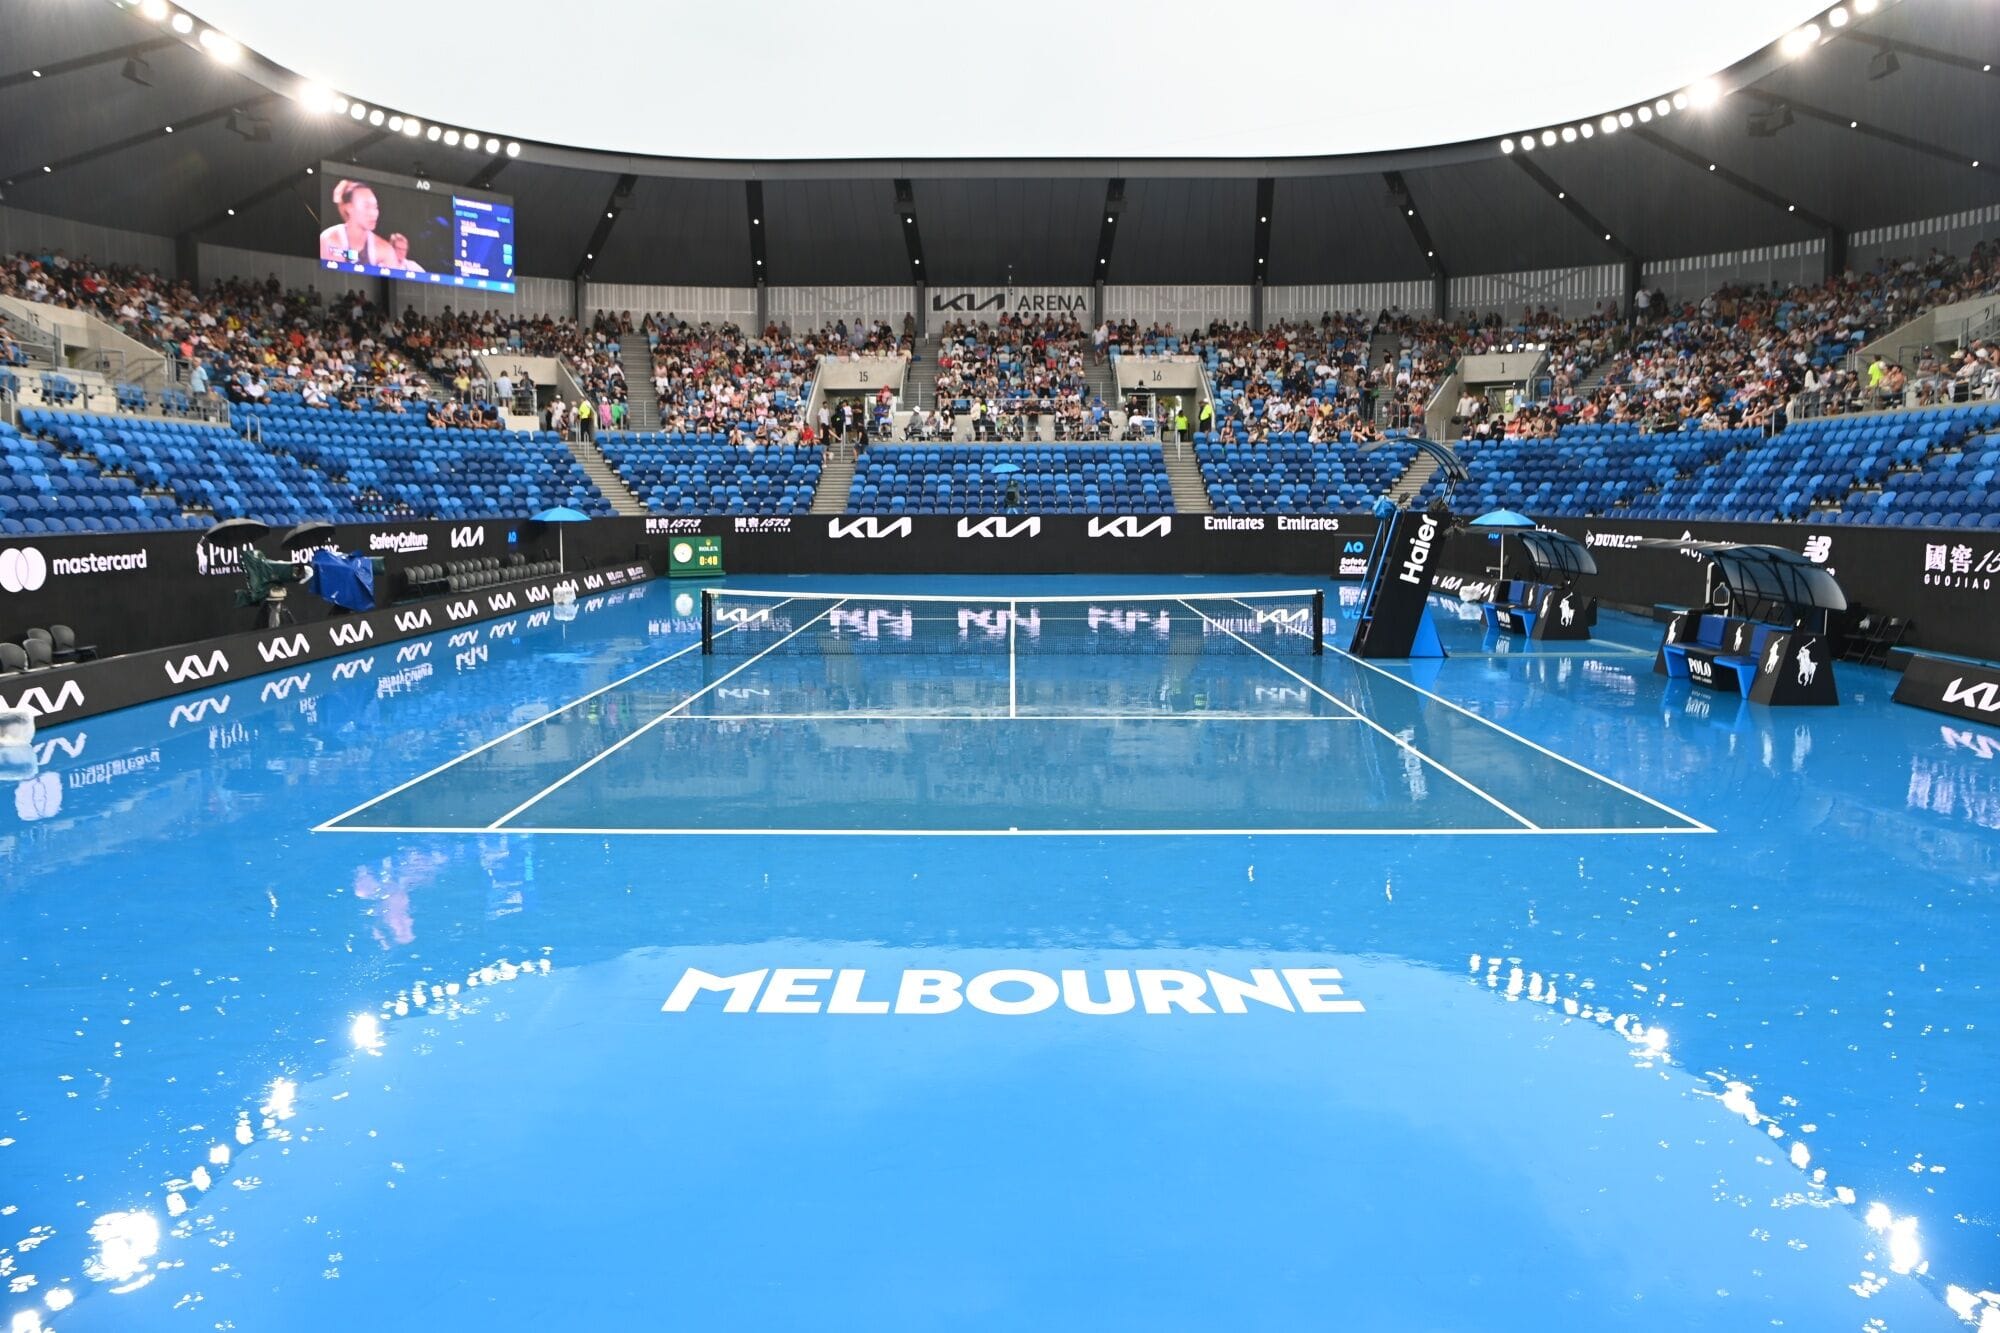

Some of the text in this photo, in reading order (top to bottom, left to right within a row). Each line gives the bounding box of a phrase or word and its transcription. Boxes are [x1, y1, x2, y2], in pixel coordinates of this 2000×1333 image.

[932, 293, 1087, 311] KIA ARENA
[859, 371, 868, 382] 15
[1153, 370, 1162, 381] 16
[829, 517, 912, 538] KIA
[958, 516, 1041, 538] KIA
[1088, 516, 1171, 538] KIA
[1204, 516, 1265, 530] Emirates
[1277, 516, 1339, 530] Emirates
[451, 526, 484, 548] KIA
[1344, 541, 1364, 553] AO
[1400, 514, 1438, 584] Haier
[53, 548, 148, 575] mastercard
[1924, 574, 1990, 590] GUOJIAO
[488, 592, 517, 611] KIA
[526, 585, 550, 603] KIA
[394, 608, 432, 632] KIA
[446, 600, 478, 620] KIA
[716, 608, 769, 622] KIA
[1256, 608, 1309, 623] KIA
[329, 620, 374, 646] KIA
[257, 633, 310, 662] KIA
[165, 650, 229, 684] KIA
[1688, 657, 1712, 678] POLO
[661, 966, 1366, 1014] MELBOURNE
